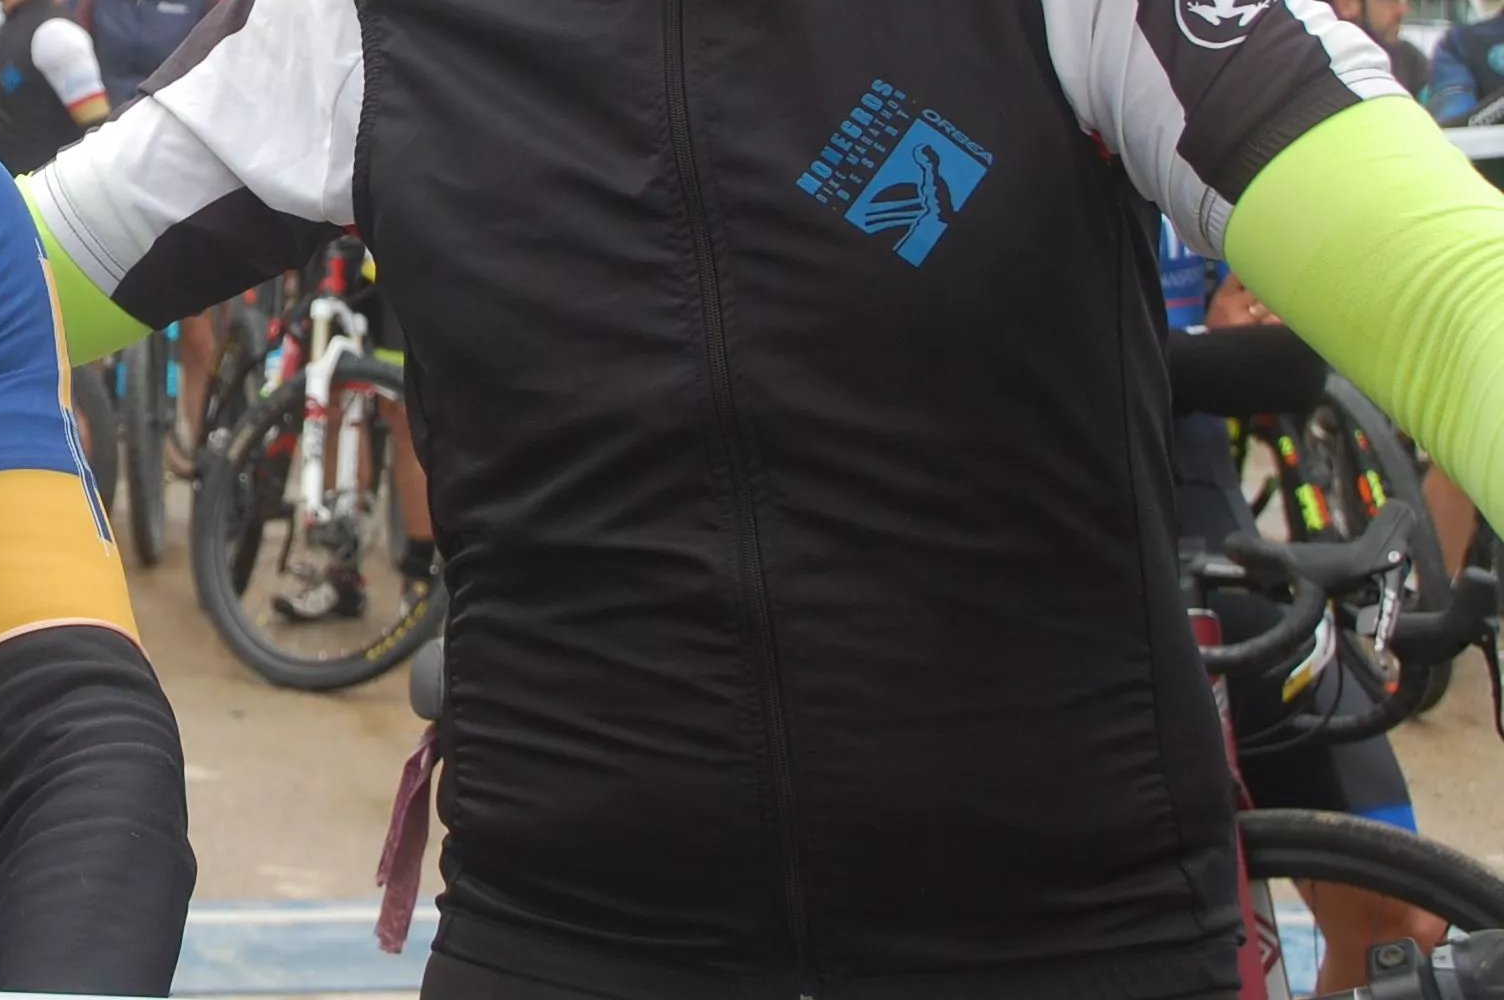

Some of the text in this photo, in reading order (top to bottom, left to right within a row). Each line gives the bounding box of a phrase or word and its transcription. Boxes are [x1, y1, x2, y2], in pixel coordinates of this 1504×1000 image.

[796, 78, 894, 196] MONEGROS
[815, 89, 907, 204] BIKE MARATHON
[836, 108, 910, 201] DESERT
[921, 108, 994, 166] ORBEA
